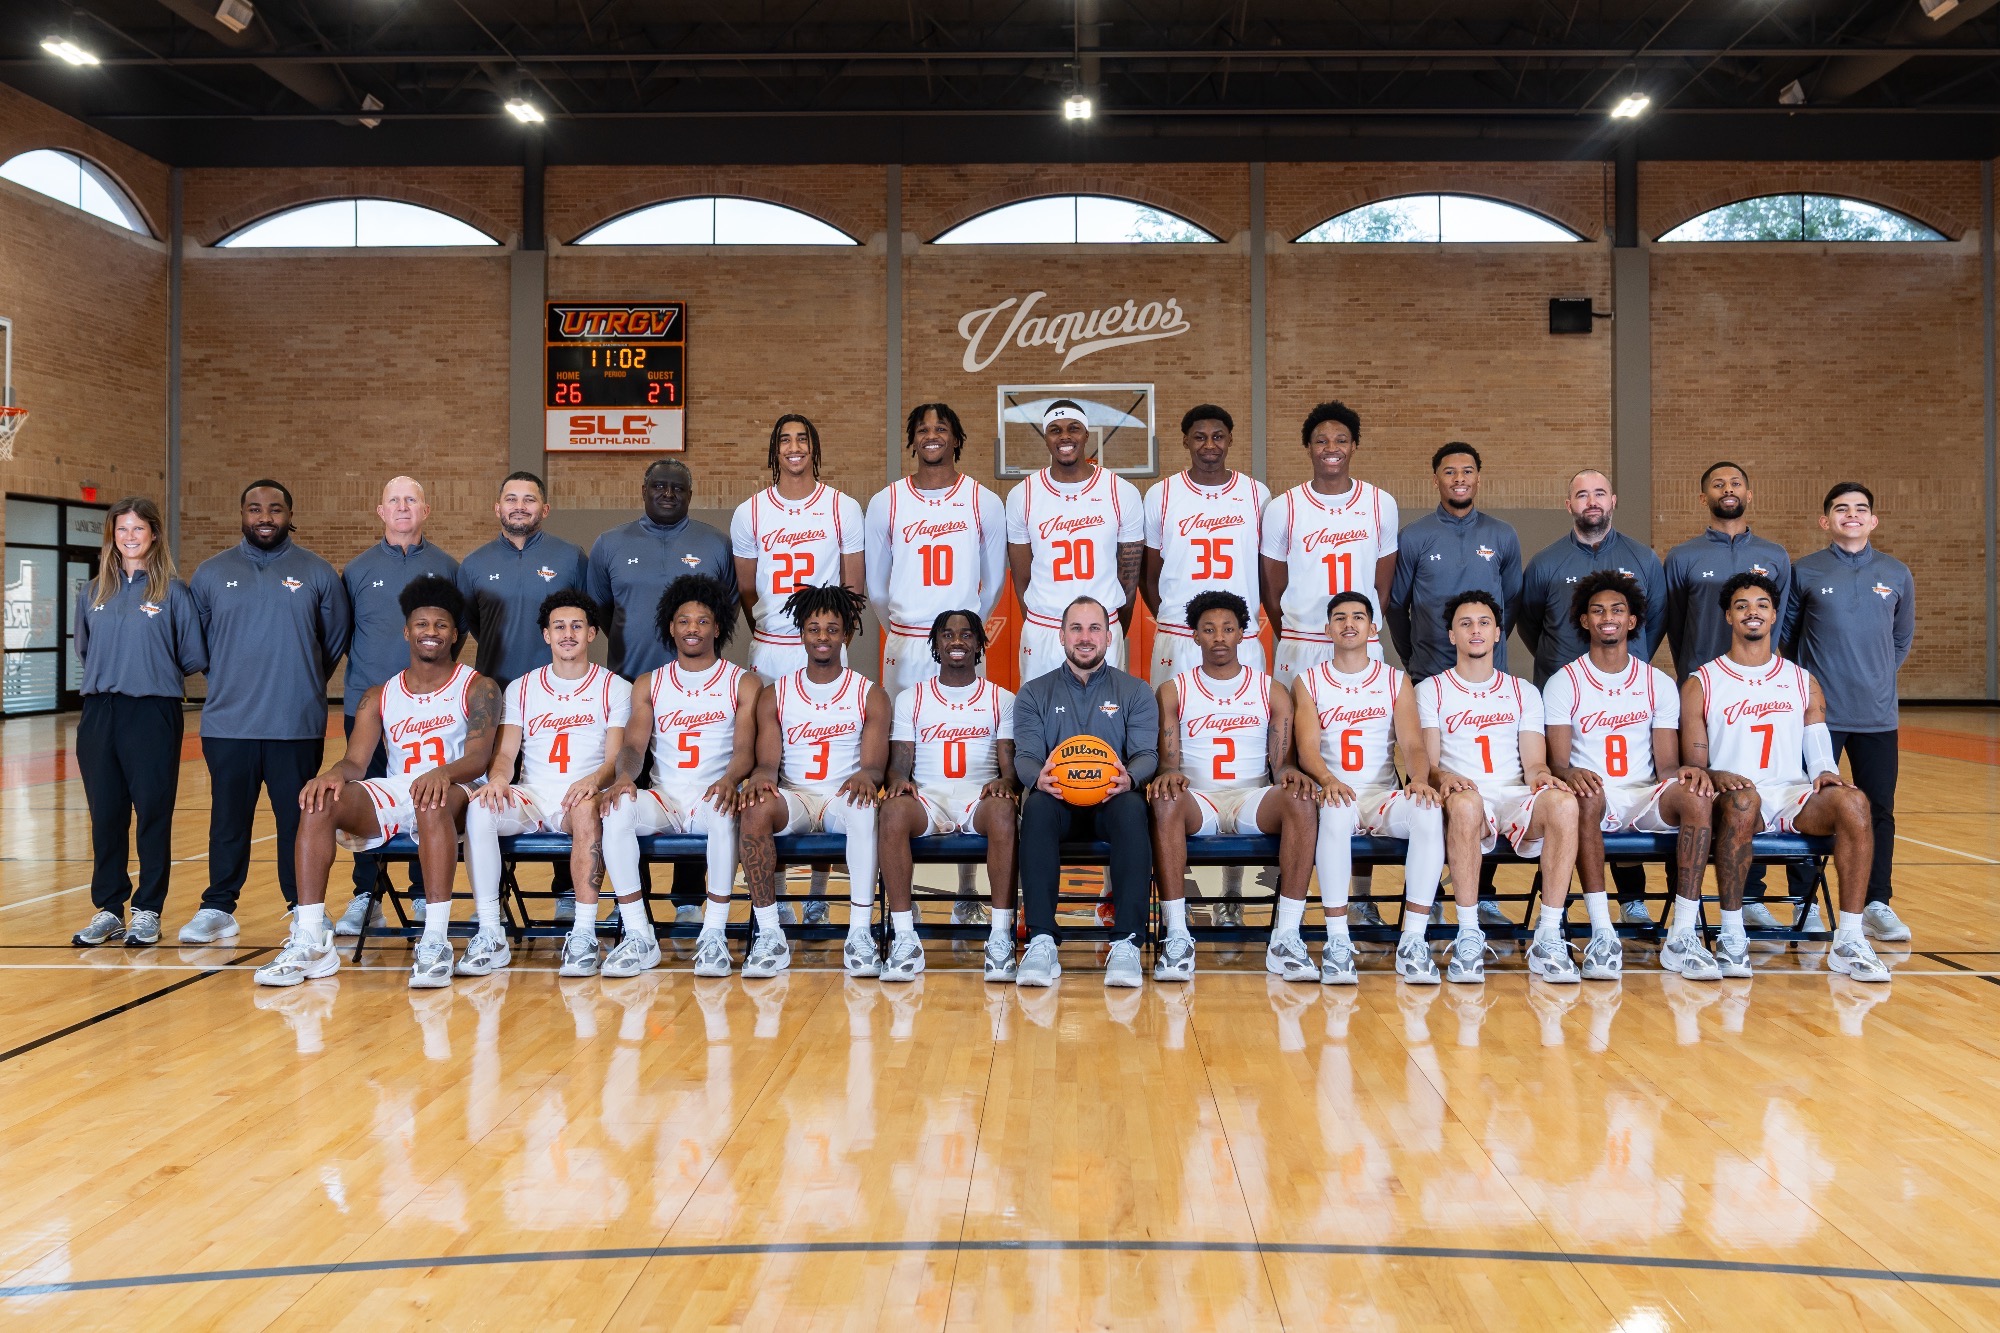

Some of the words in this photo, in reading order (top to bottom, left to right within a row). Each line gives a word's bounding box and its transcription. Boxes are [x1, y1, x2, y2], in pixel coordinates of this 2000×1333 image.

[558, 309, 677, 336] UTRGV
[957, 291, 1191, 373] Vaqueros
[592, 348, 646, 369] 11:02
[556, 371, 580, 380] HOME
[647, 371, 674, 380] GUEST
[555, 383, 582, 404] 26
[648, 383, 675, 404] 27
[569, 415, 649, 435] SLC
[569, 437, 651, 445] SOUTHLAND
[902, 519, 968, 543] Vaqueros
[1038, 515, 1105, 540] Vaqueros
[1178, 512, 1245, 534] Vaqueros
[762, 527, 827, 552] Vaqueros
[1303, 527, 1369, 552] Vaqueros
[918, 544, 953, 586] 10
[1051, 538, 1095, 582] 20
[1190, 538, 1234, 580] 35
[772, 552, 815, 594] 22
[1321, 553, 1352, 596] 11
[528, 712, 595, 736] Vaqueros
[658, 710, 727, 732] Vaqueros
[1319, 705, 1387, 730] Vaqueros
[1446, 709, 1516, 734] Vaqueros
[1580, 710, 1650, 734] Vaqueros
[1723, 699, 1793, 726] Vaqueros
[389, 713, 456, 743] Vaqueros
[787, 721, 856, 744] Vaqueros
[920, 722, 990, 743] Vaqueros
[1187, 713, 1261, 738] Vaqueros
[401, 737, 448, 774] 23
[549, 733, 571, 773] 4
[677, 731, 701, 769] 5
[1061, 744, 1108, 759] Wilson
[1212, 737, 1236, 780] 2
[1340, 729, 1364, 772] 6
[1474, 735, 1494, 773] 1
[1605, 734, 1628, 777] 8
[1750, 723, 1774, 770] 7
[804, 741, 830, 780] 3
[943, 741, 967, 779] 0
[1067, 769, 1103, 780] NCAA
